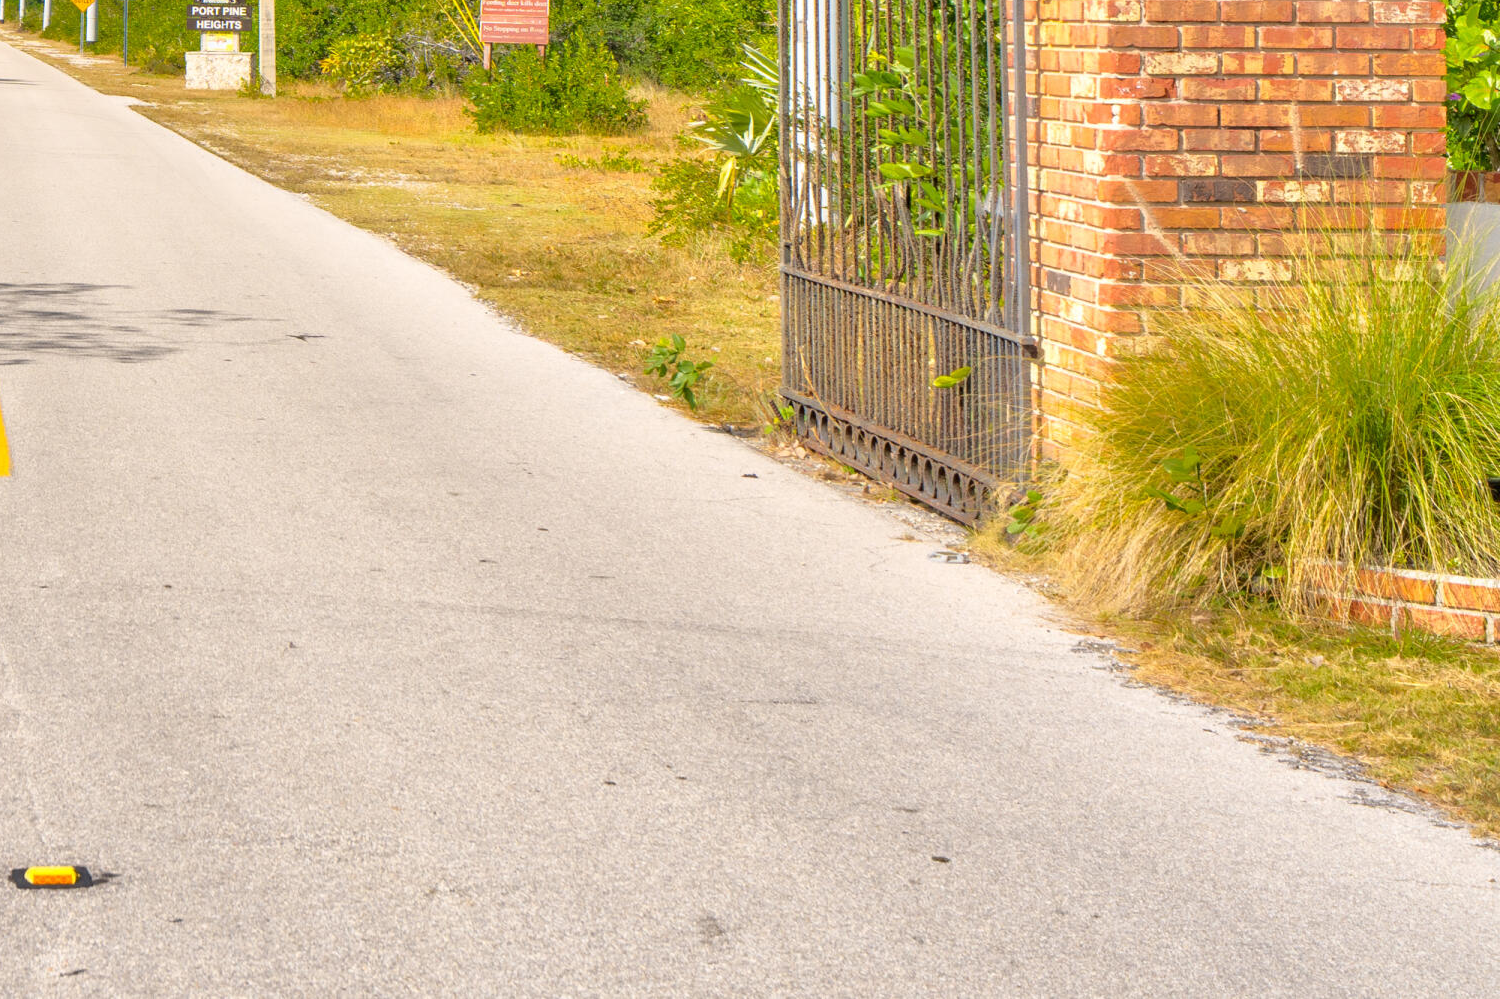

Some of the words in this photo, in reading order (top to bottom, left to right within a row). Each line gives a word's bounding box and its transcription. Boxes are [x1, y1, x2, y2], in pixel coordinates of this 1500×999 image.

[191, 6, 220, 16] PORT
[222, 6, 247, 16] PINE
[196, 20, 242, 29] HEIGHTS
